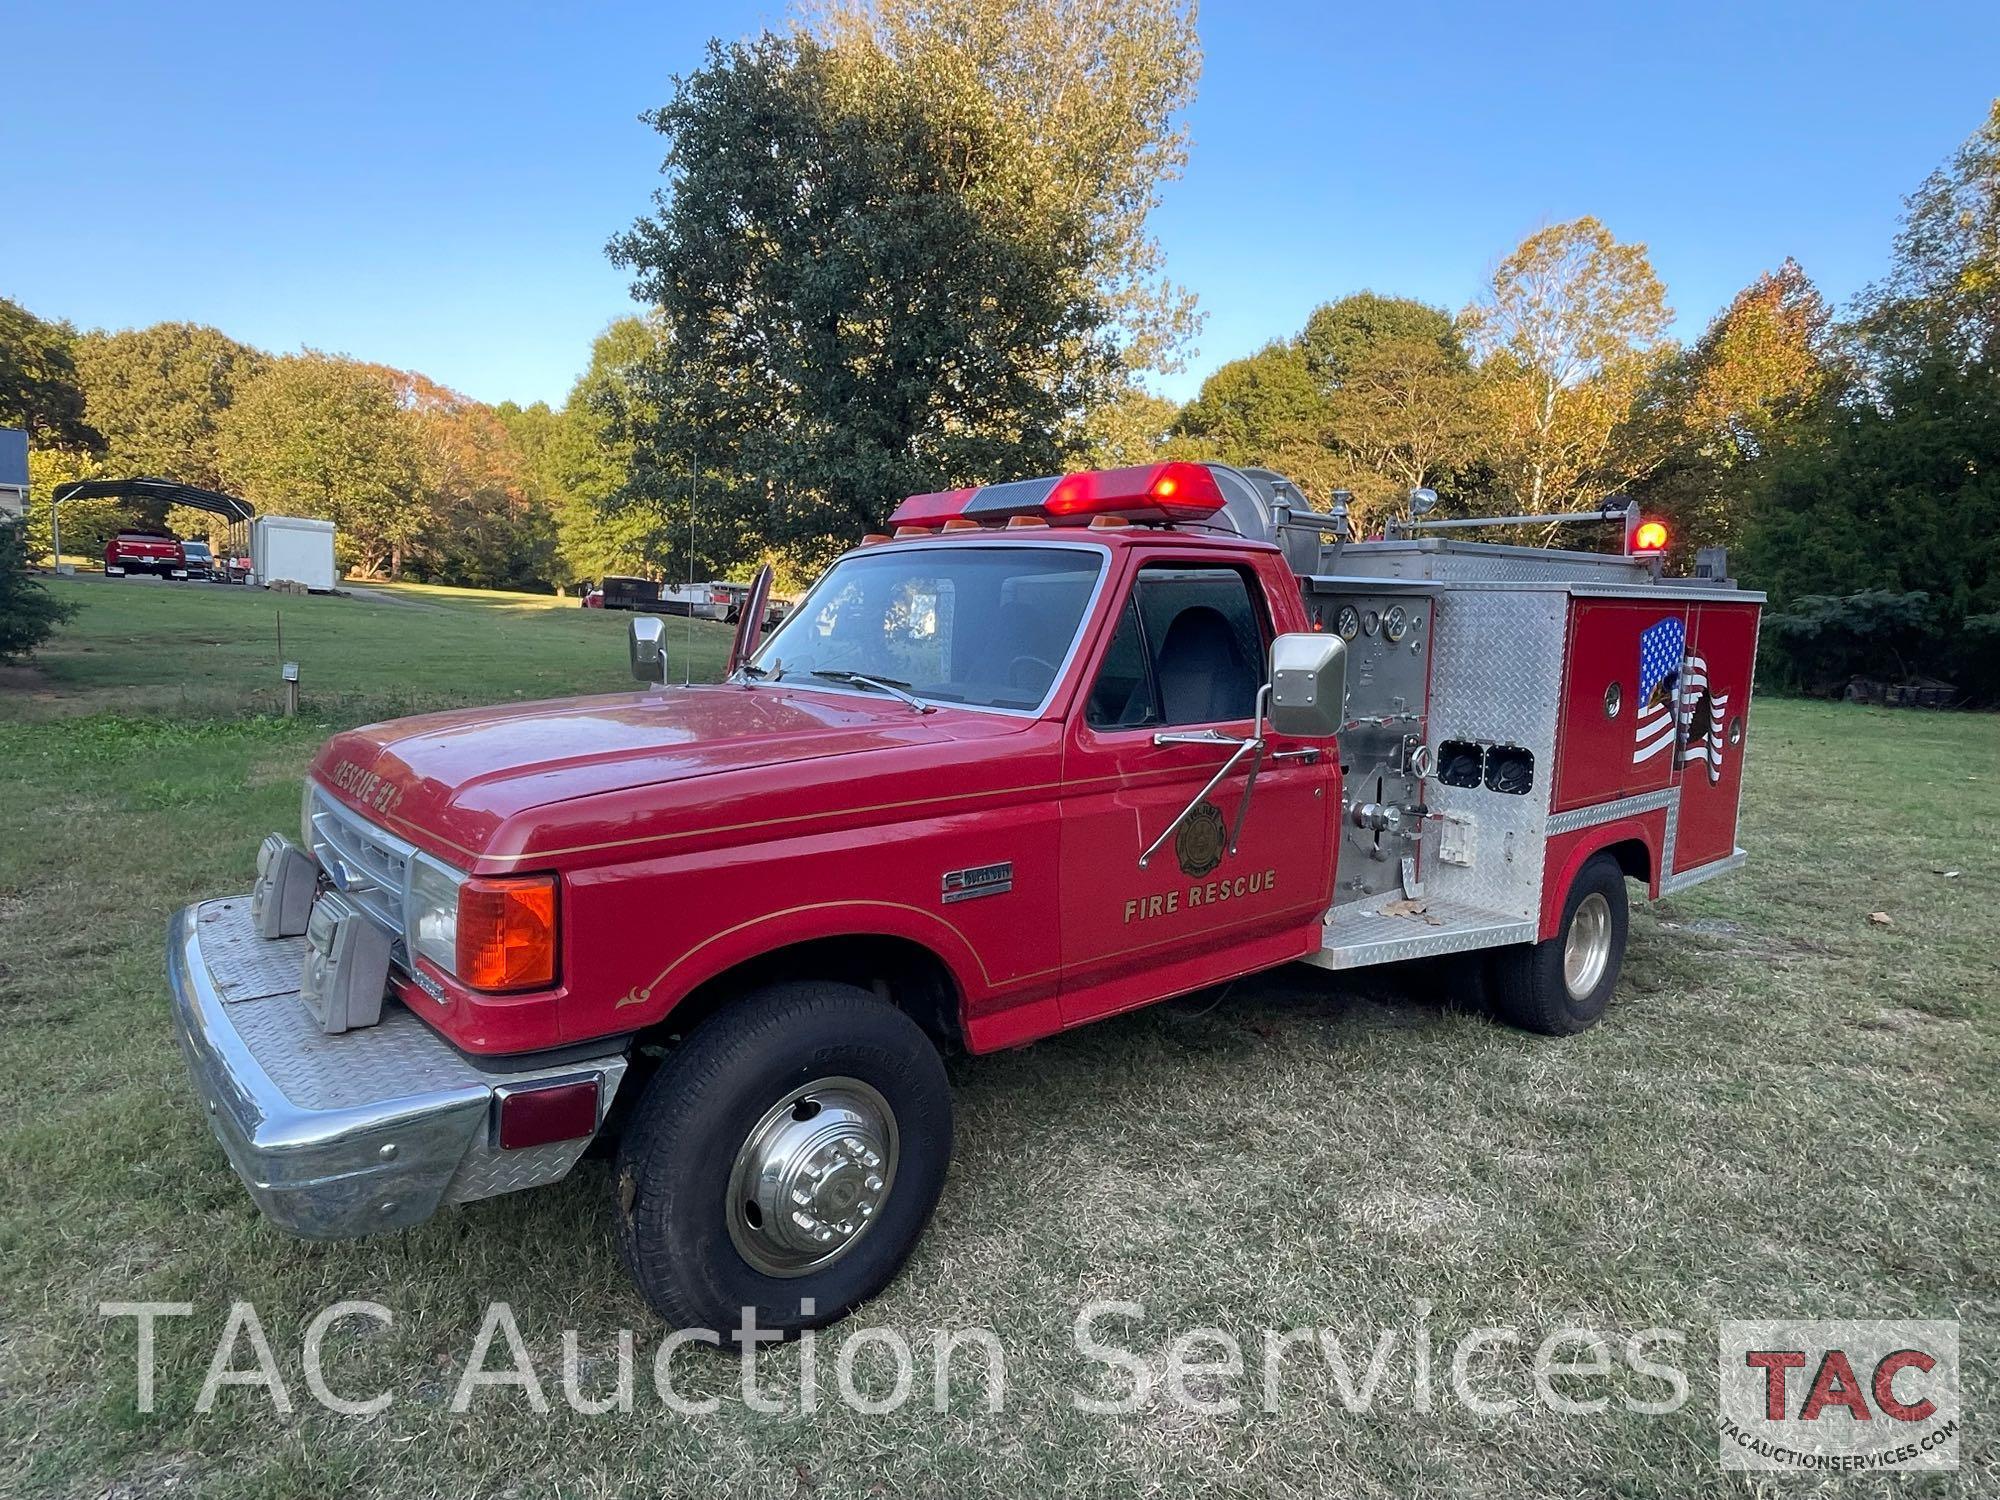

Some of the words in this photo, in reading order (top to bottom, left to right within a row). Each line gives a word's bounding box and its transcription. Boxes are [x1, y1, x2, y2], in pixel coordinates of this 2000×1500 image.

[332, 760, 381, 803] RESCUE
[372, 781, 398, 813] #1
[1123, 890, 1180, 924] FIRE
[1188, 869, 1276, 908] RESCUE
